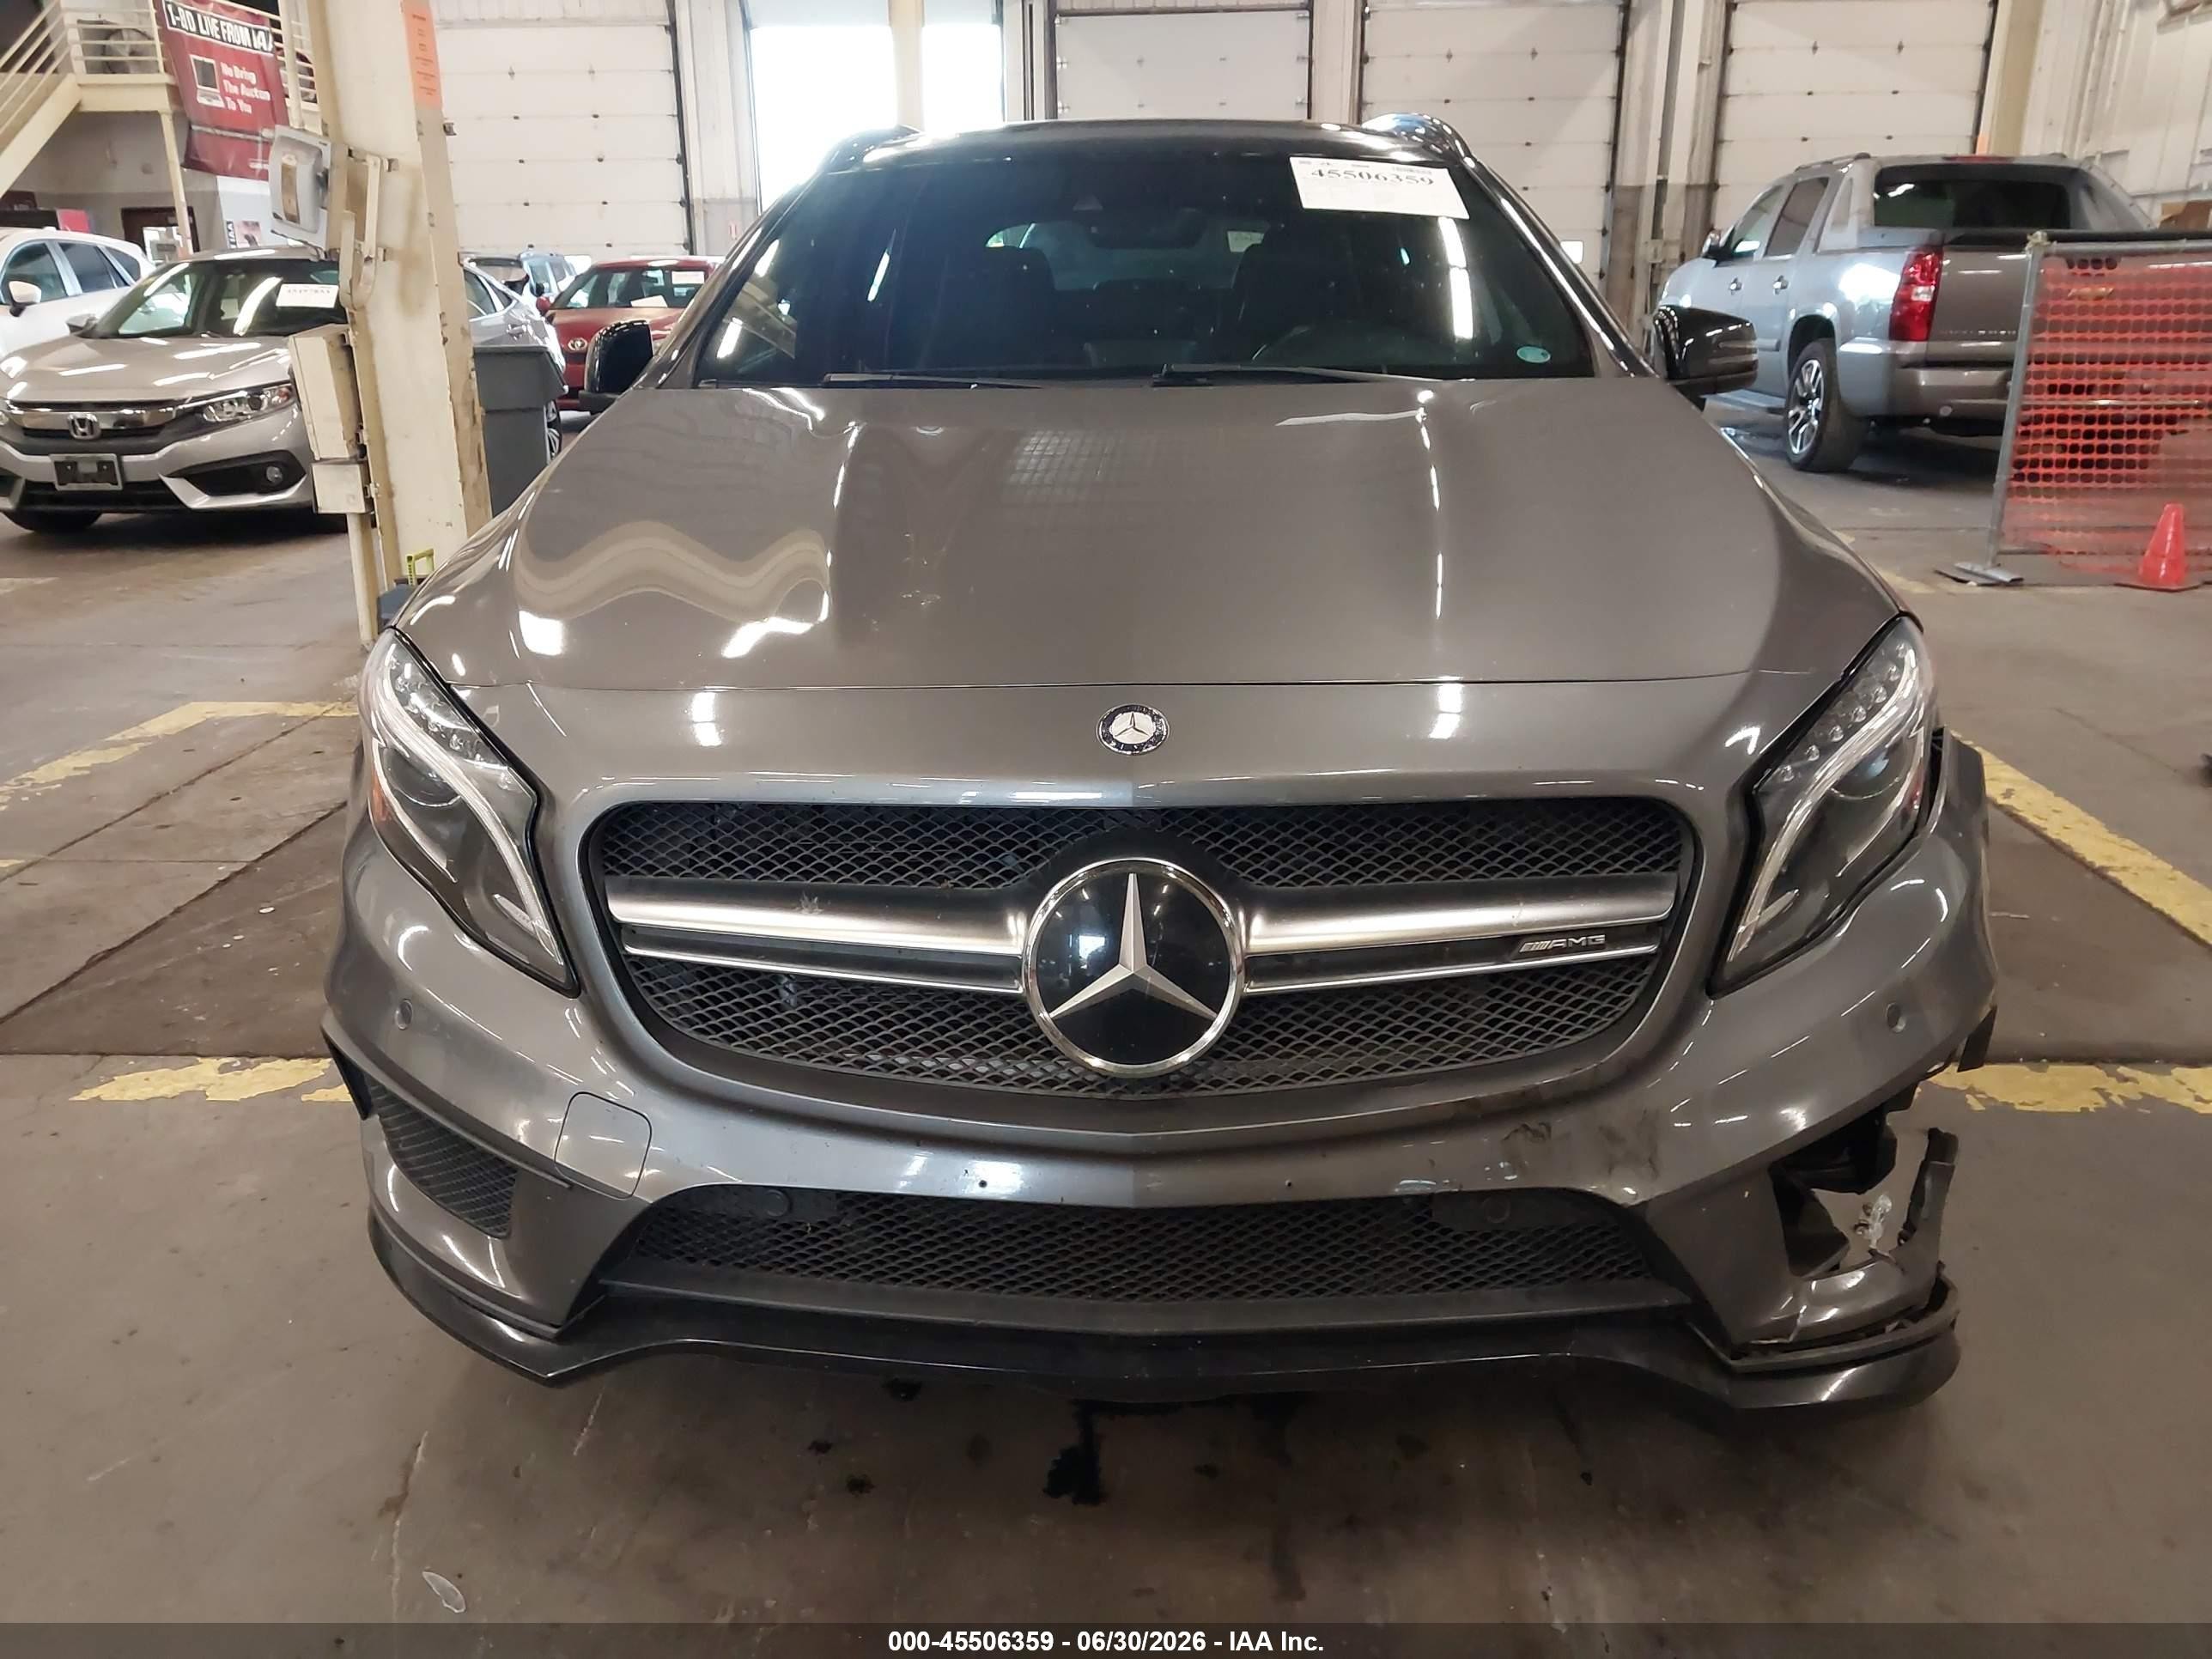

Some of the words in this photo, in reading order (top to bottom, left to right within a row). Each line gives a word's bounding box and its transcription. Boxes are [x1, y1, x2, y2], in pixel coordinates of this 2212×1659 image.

[220, 20, 252, 48] FROM
[1311, 169, 1434, 185] 45506359
[1543, 934, 1606, 951] AMG
